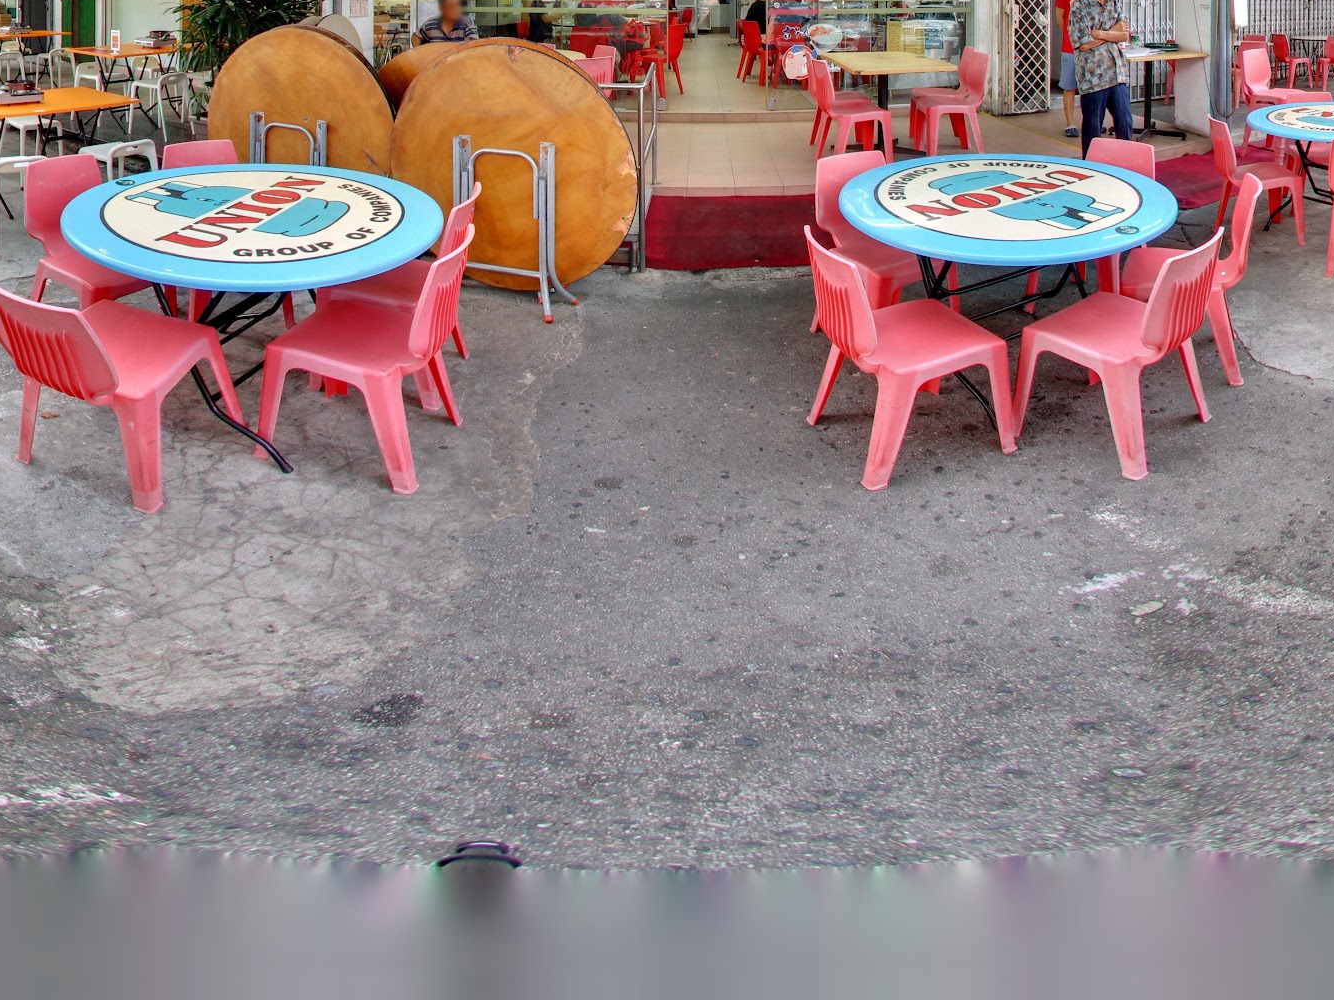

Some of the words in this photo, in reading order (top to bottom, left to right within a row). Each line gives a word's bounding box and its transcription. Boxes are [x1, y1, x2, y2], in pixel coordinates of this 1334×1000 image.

[982, 161, 1049, 169] GROUP
[887, 167, 938, 201] COMPANIES
[904, 169, 1096, 222] UNION
[154, 175, 326, 249] UNION
[336, 183, 393, 223] COMPANIES
[232, 241, 335, 257] GROUP
[345, 226, 376, 240] OF
